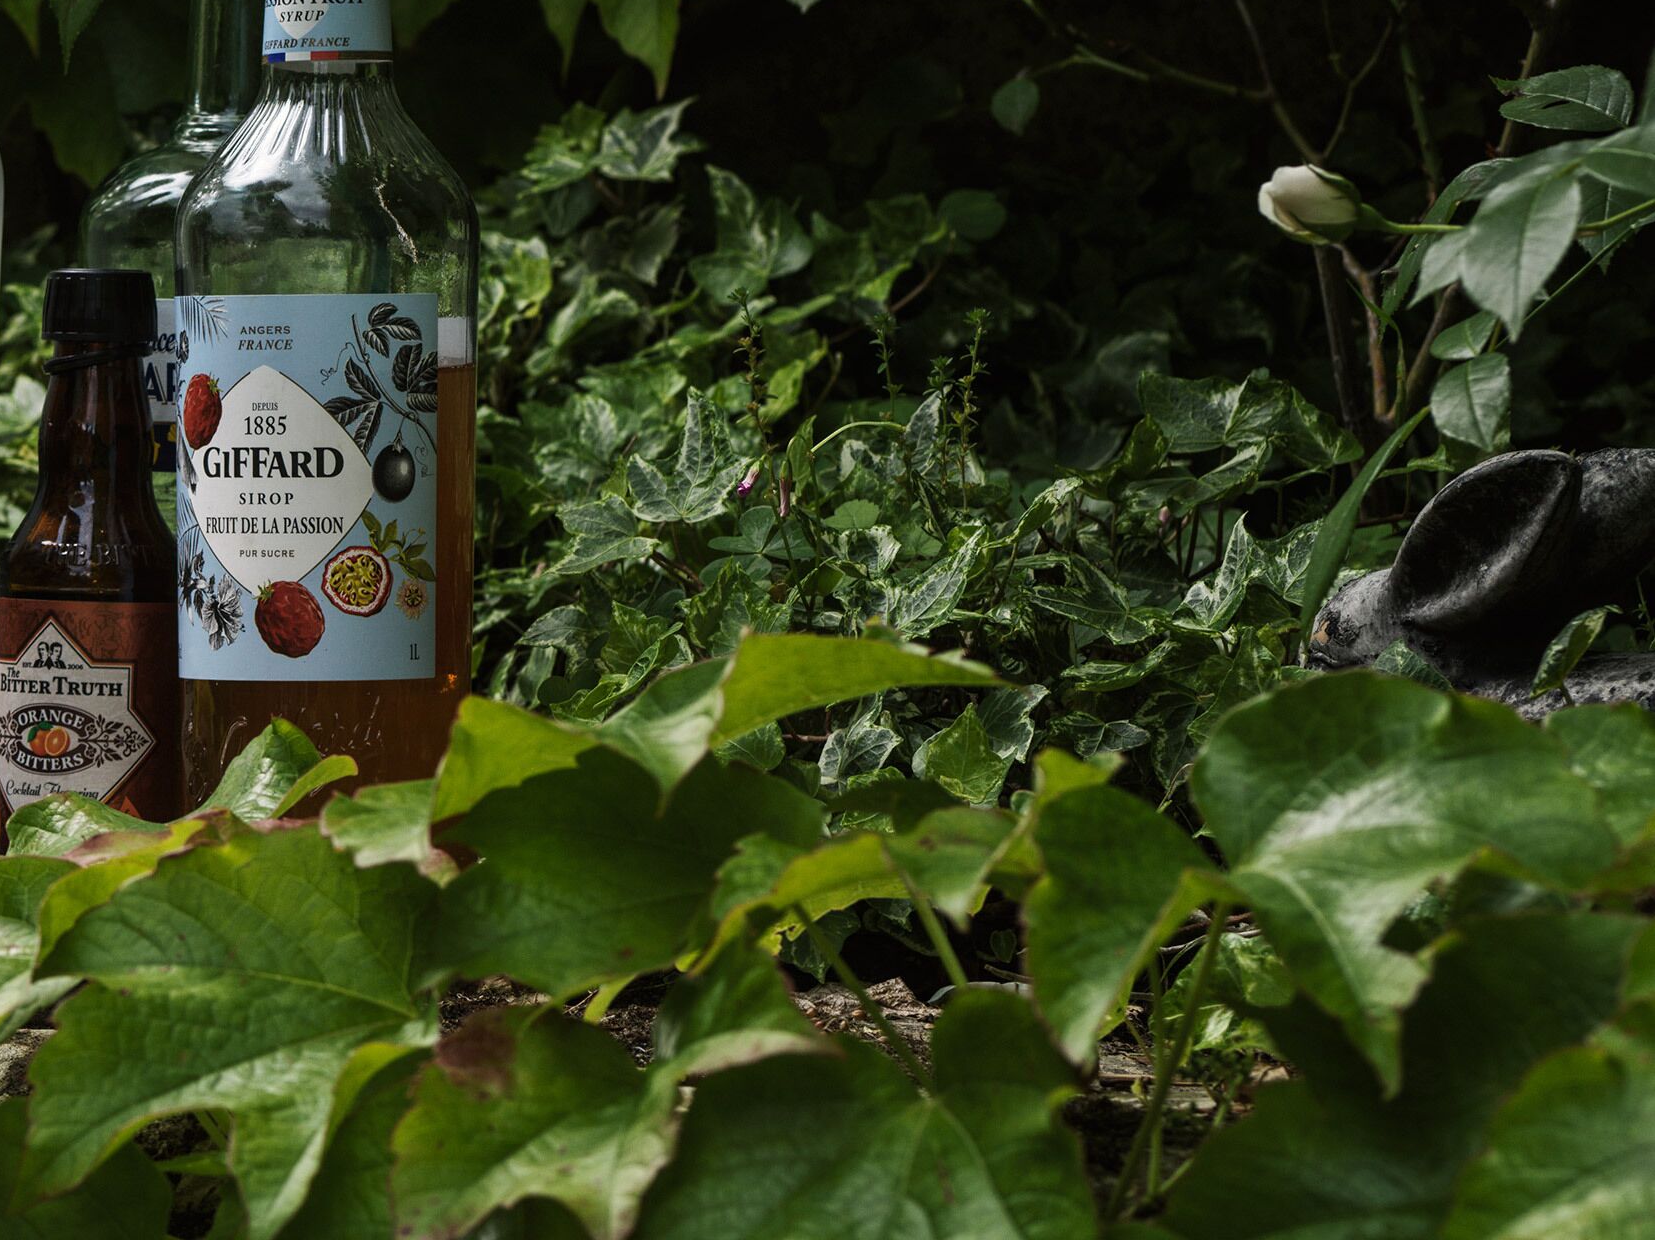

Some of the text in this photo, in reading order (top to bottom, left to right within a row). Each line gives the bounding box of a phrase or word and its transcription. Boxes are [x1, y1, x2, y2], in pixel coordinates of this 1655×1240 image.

[279, 10, 325, 23] SYRUP
[301, 37, 350, 48] FRANCE
[240, 325, 291, 335] ANGERS
[238, 338, 293, 351] FRANCE
[252, 402, 278, 411] DEPUIS
[244, 415, 287, 436] 1885
[203, 447, 344, 479] GIFFARD
[239, 492, 294, 505] SIROP
[206, 517, 344, 534] FRUIT DE LA PASSION
[239, 549, 295, 558] PUR SUCRE
[410, 643, 420, 660] 1L
[7, 666, 20, 678] The
[0, 675, 123, 697] BITTER TRUTH
[17, 710, 86, 730] ORANGE
[16, 749, 85, 772] BITTERS
[6, 779, 41, 796] Cocktail
